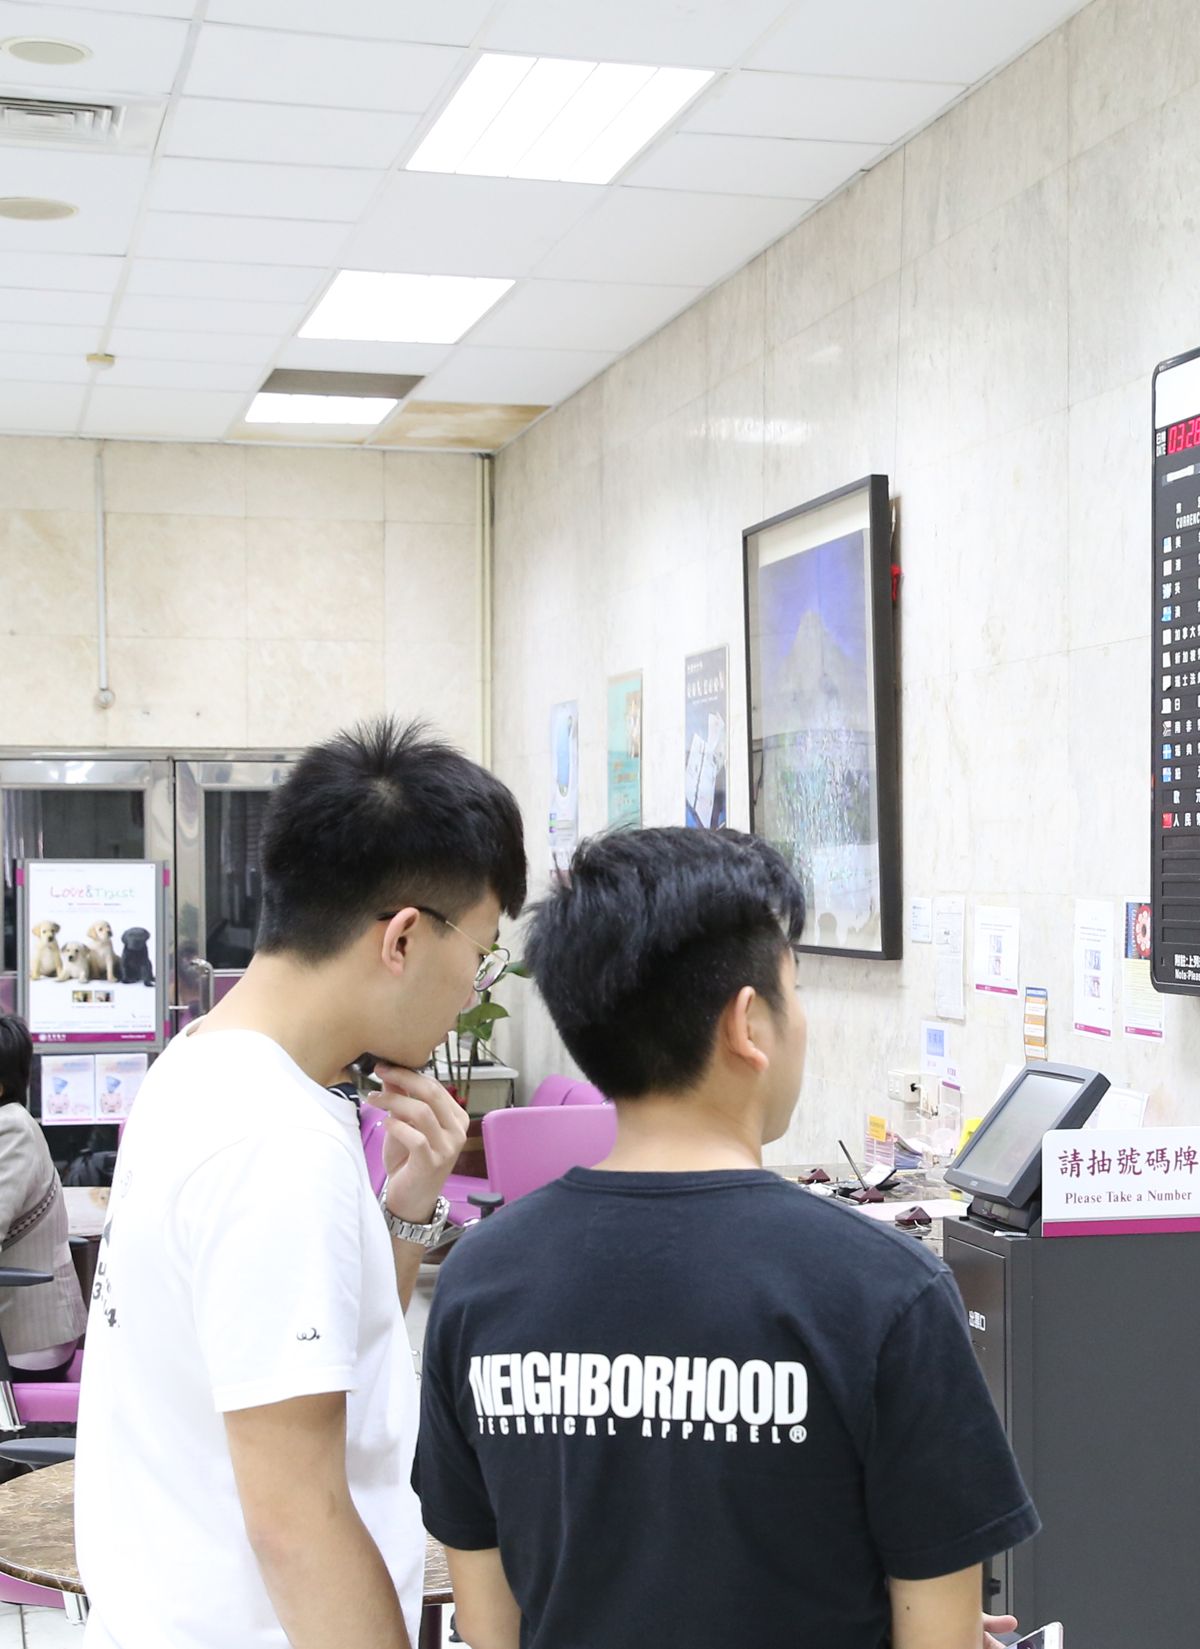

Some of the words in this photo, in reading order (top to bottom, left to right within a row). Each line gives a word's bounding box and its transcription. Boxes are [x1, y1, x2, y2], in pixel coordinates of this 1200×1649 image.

[1058, 1145, 1199, 1178] 請抽號碼牌
[1065, 1191, 1102, 1204] Please
[1105, 1190, 1132, 1203] Take
[1147, 1190, 1192, 1201] Number
[468, 1351, 809, 1425] NEIGHBORHOOD
[478, 1416, 617, 1436] TECHNICAL
